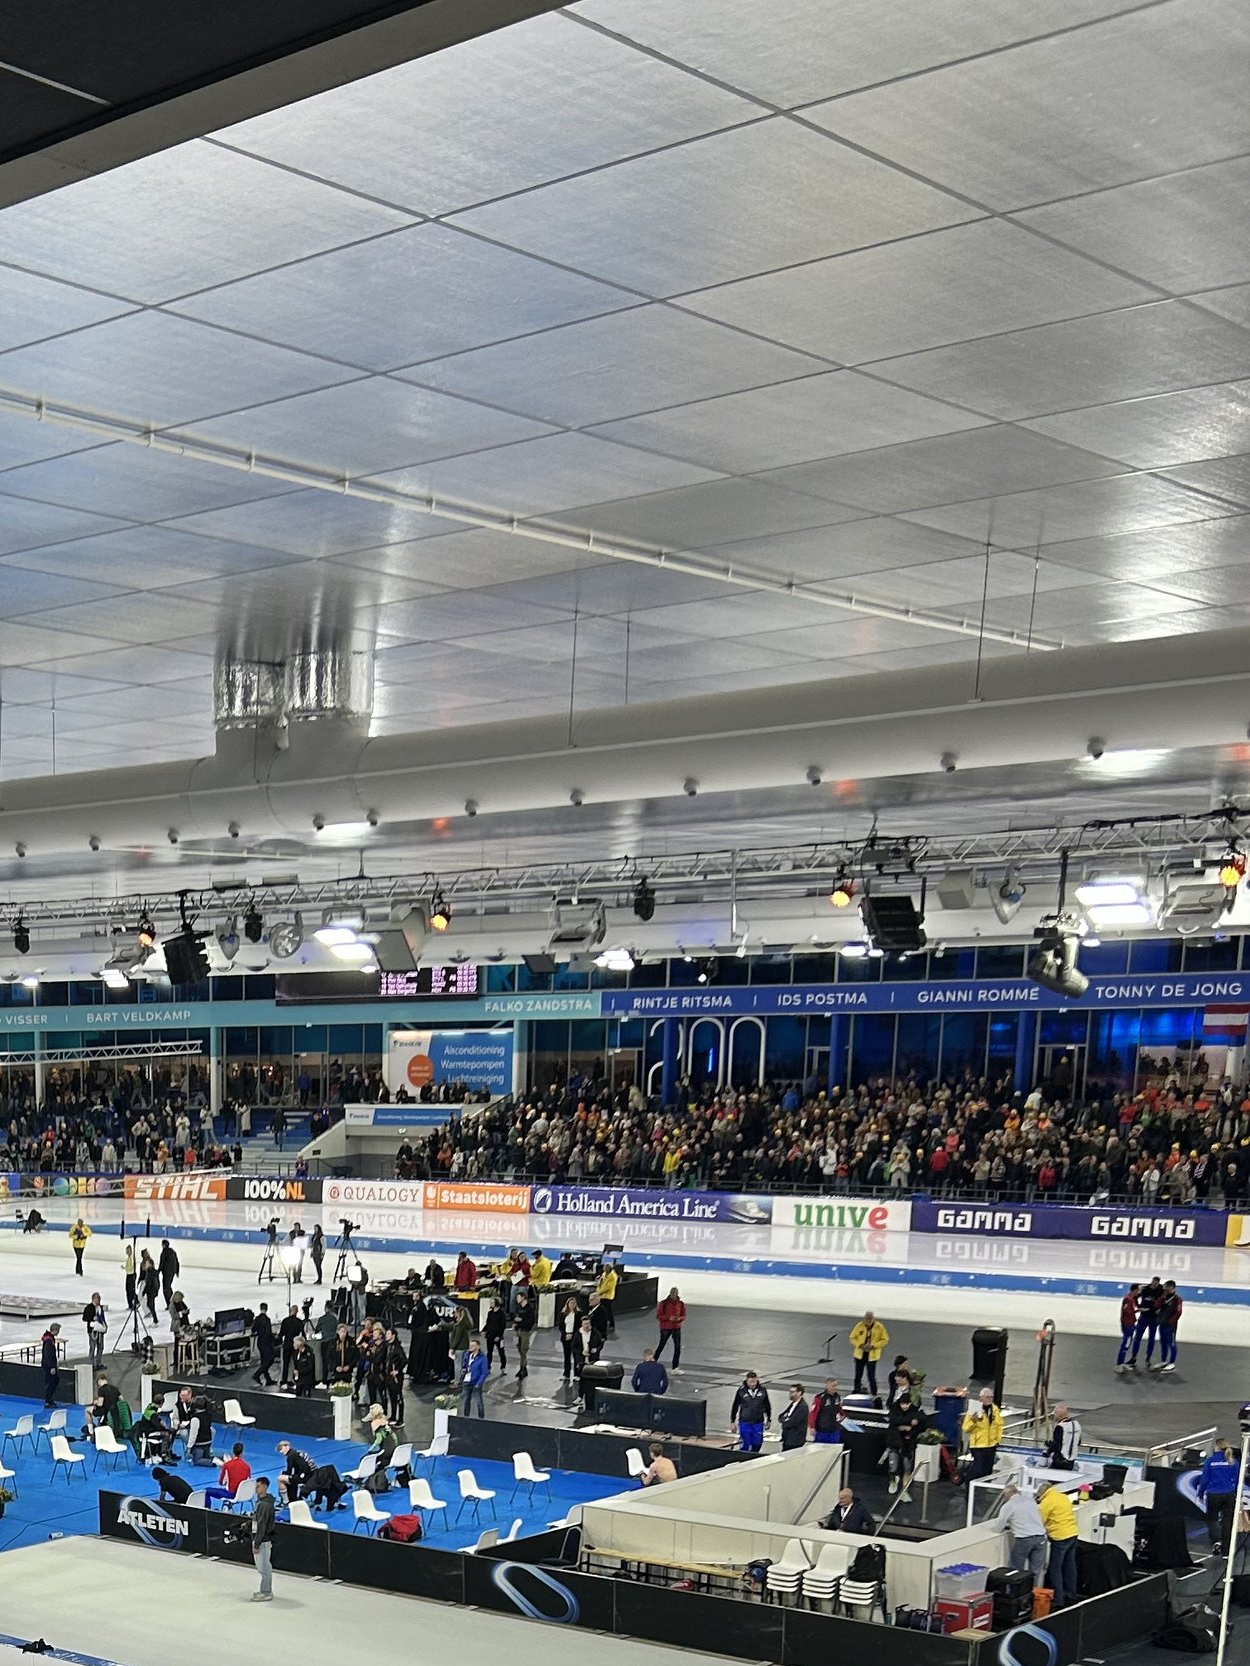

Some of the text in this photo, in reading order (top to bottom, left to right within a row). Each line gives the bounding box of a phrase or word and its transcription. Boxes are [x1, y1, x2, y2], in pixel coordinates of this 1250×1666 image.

[918, 987, 1039, 1003] GIANNI ROMME
[1095, 983, 1242, 999] TONNY DE JONG
[485, 999, 592, 1013] FALKO ZANDSTRA
[632, 995, 732, 1009] RINTJE RITSMA
[777, 992, 867, 1006] IDS POSTMA
[4, 1014, 48, 1025] VISSER
[86, 1010, 191, 1023] BART VELDKAMP
[444, 1045, 505, 1056] Airconditioning
[440, 1059, 505, 1071] Warmtepompen
[244, 1180, 306, 1200] 100%NL
[343, 1186, 420, 1202] QUALOGY
[440, 1190, 528, 1210] Staatsloterij
[556, 1192, 614, 1214] Holland
[615, 1194, 680, 1217] America
[117, 1509, 189, 1536] ATLETEN
